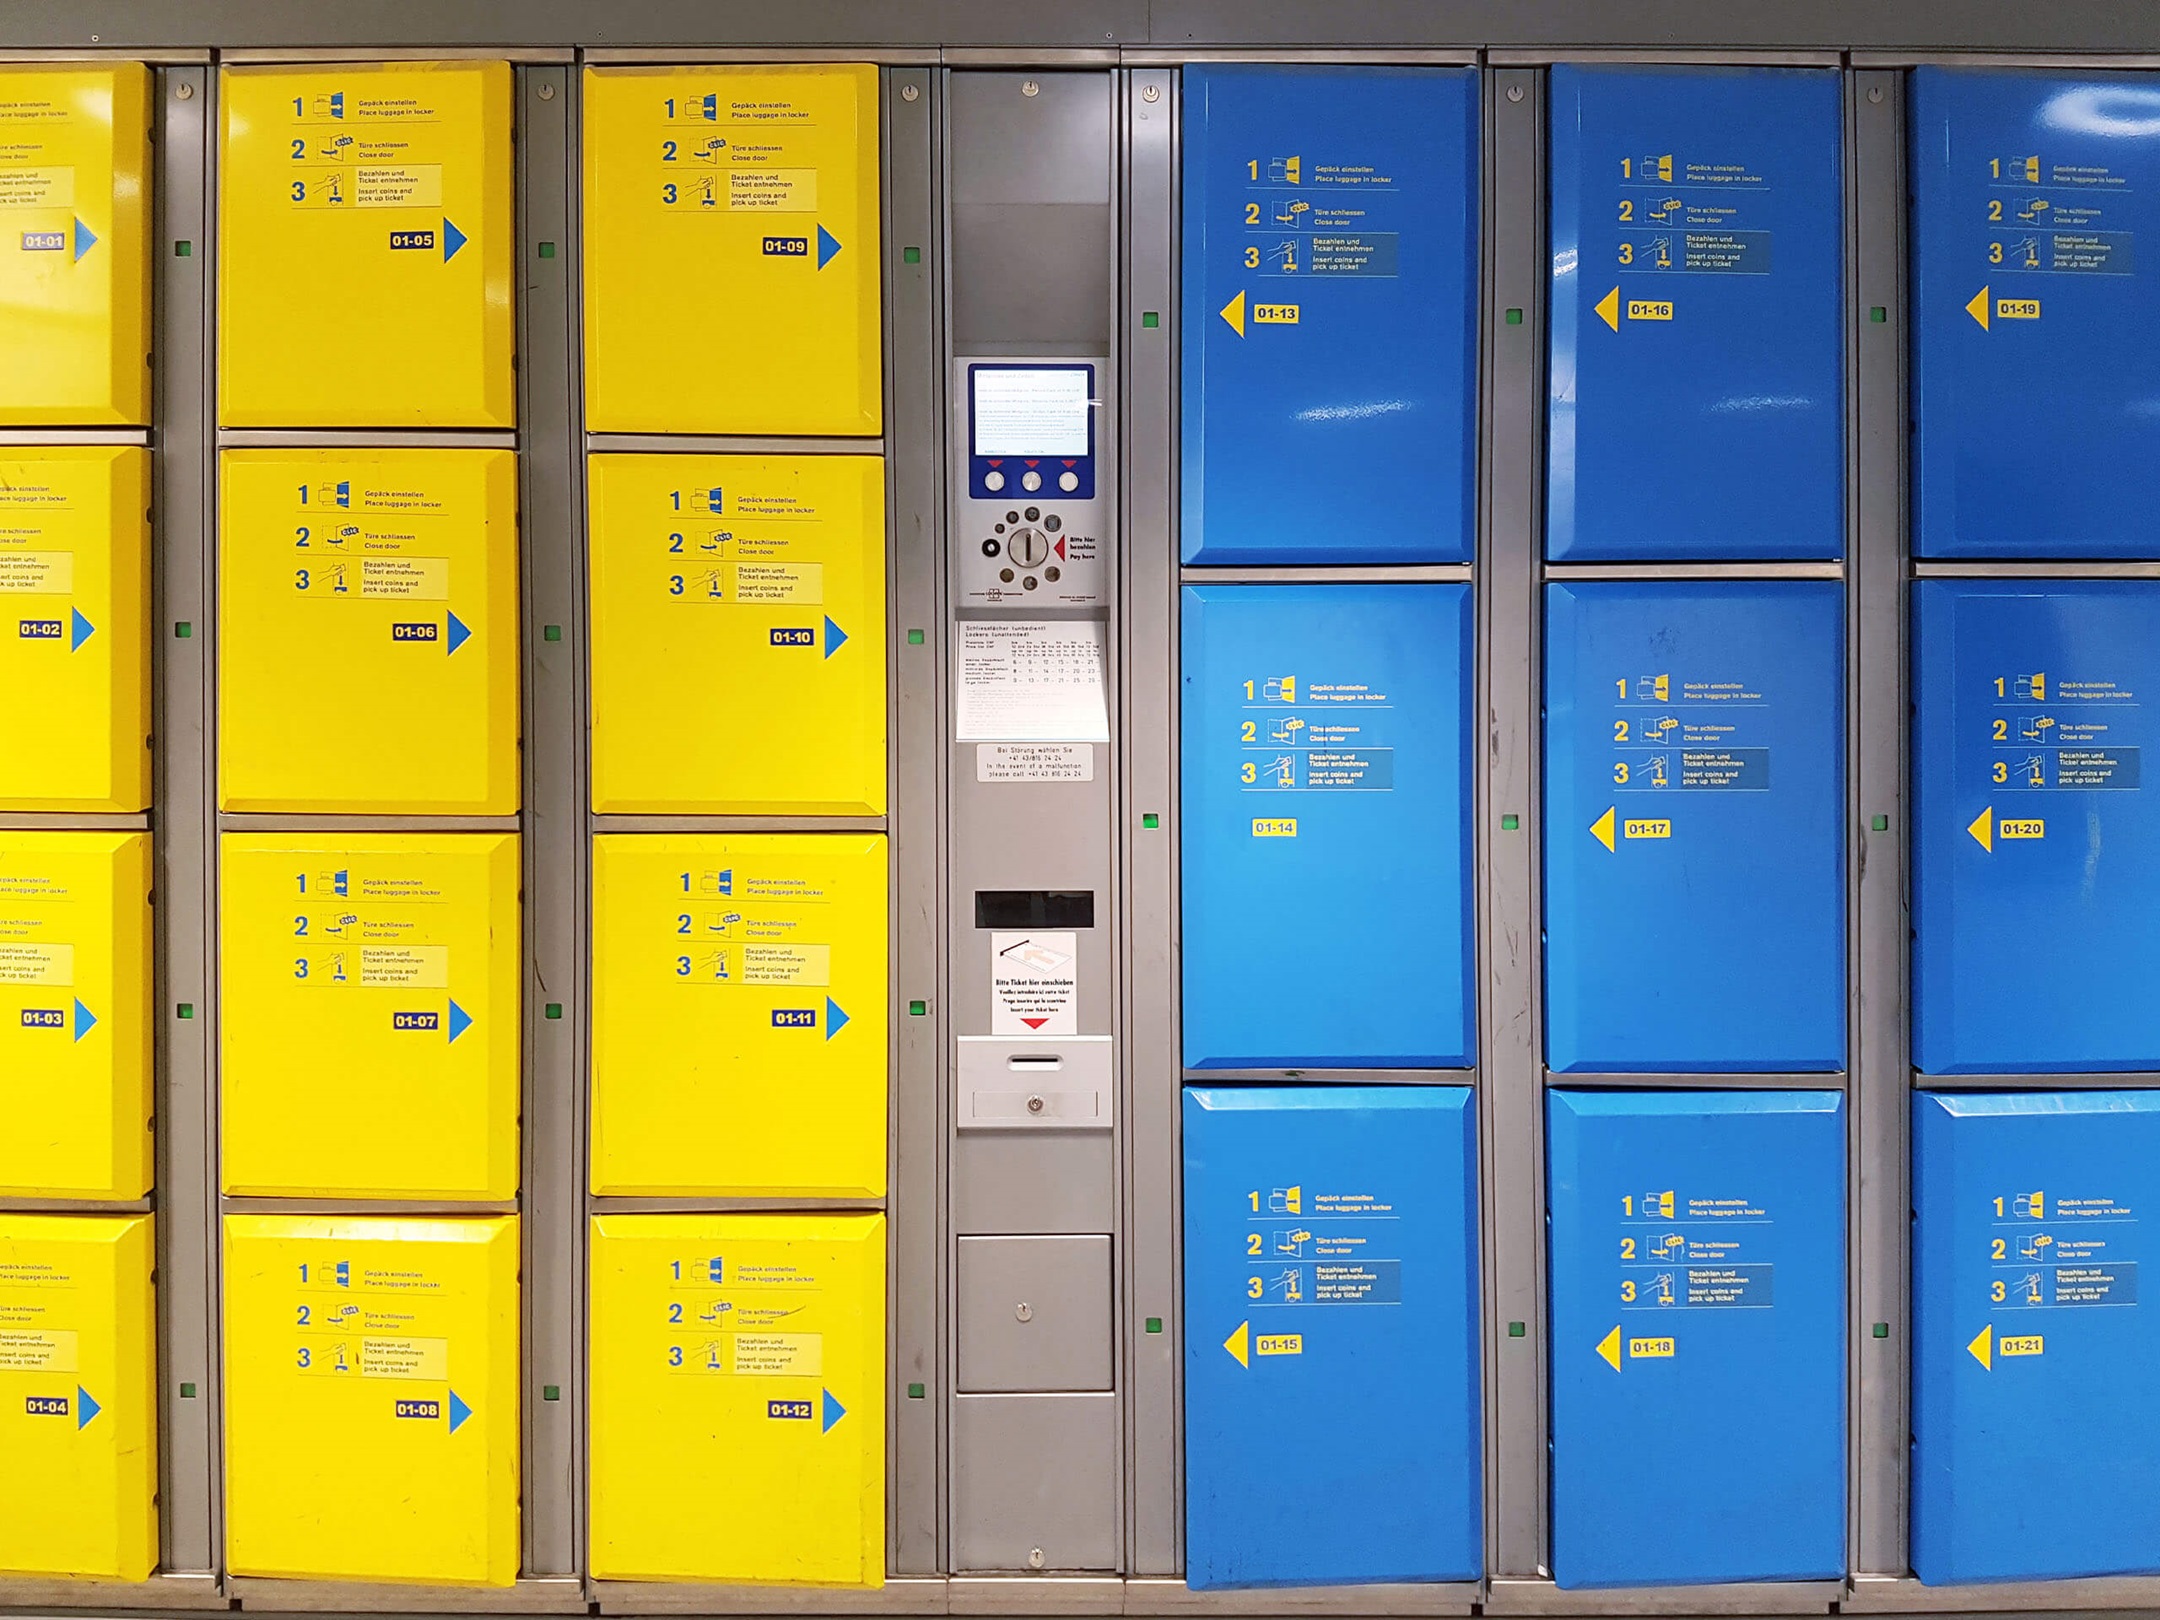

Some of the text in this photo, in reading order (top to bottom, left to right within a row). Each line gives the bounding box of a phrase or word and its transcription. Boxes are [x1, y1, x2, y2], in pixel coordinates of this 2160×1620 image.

[293, 98, 302, 116] 1
[664, 99, 674, 118] 1
[291, 140, 305, 159] 2
[662, 141, 677, 161] 2
[1248, 160, 1257, 180] 1
[1622, 159, 1631, 178] 1
[1990, 159, 1999, 177] 1
[291, 182, 305, 201] 3
[663, 184, 677, 204] 3
[1245, 203, 1260, 224] 2
[1619, 200, 1633, 221] 2
[1988, 201, 2002, 221] 2
[25, 236, 63, 249] 01-01
[392, 235, 432, 247] 01-05
[765, 241, 805, 253] 01-09
[1244, 247, 1259, 268] 3
[1618, 244, 1633, 264] 3
[1989, 243, 2003, 263] 3
[1257, 308, 1296, 319] 01-13
[1631, 305, 1669, 316] 01-16
[2000, 304, 2036, 315] 01-19
[298, 485, 307, 504] 1
[670, 491, 680, 510] 1
[295, 527, 310, 547] 2
[669, 533, 683, 553] 2
[295, 570, 310, 590] 3
[669, 575, 684, 595] 3
[21, 624, 60, 635] 01-02
[395, 627, 435, 638] 01-06
[773, 632, 811, 643] 01-10
[1244, 681, 1254, 699] 1
[1616, 679, 1626, 698] 1
[1995, 678, 2004, 696] 1
[1241, 722, 1255, 741] 2
[1614, 721, 1628, 741] 2
[1993, 720, 2007, 740] 2
[1241, 763, 1256, 783] 3
[1614, 763, 1629, 783] 3
[1993, 762, 2007, 782] 3
[1255, 823, 1293, 833] 01-14
[1629, 824, 1666, 835] 01-17
[2003, 824, 2041, 835] 01-20
[297, 874, 306, 893] 1
[680, 873, 690, 892] 1
[294, 916, 308, 936] 2
[677, 914, 692, 934] 2
[294, 958, 308, 978] 3
[676, 956, 691, 976] 3
[24, 1013, 62, 1024] 01-03
[396, 1016, 436, 1027] 01-07
[775, 1013, 812, 1024] 01-11
[1248, 1192, 1259, 1211] 1
[1622, 1196, 1632, 1216] 1
[1993, 1198, 2003, 1216] 1
[1247, 1234, 1262, 1254] 2
[1621, 1238, 1635, 1258] 2
[1991, 1239, 2005, 1259] 2
[299, 1264, 308, 1282] 1
[671, 1261, 680, 1280] 1
[1247, 1277, 1263, 1298] 3
[1621, 1281, 1636, 1302] 3
[1991, 1281, 2005, 1302] 3
[297, 1305, 310, 1325] 2
[668, 1303, 683, 1323] 2
[1260, 1340, 1298, 1351] 01-15
[1633, 1342, 1671, 1353] 01-18
[2004, 1341, 2039, 1352] 01-21
[297, 1348, 311, 1368] 3
[668, 1346, 683, 1366] 3
[28, 1401, 66, 1413] 01-04
[398, 1404, 437, 1416] 01-08
[771, 1404, 809, 1417] 01-12
